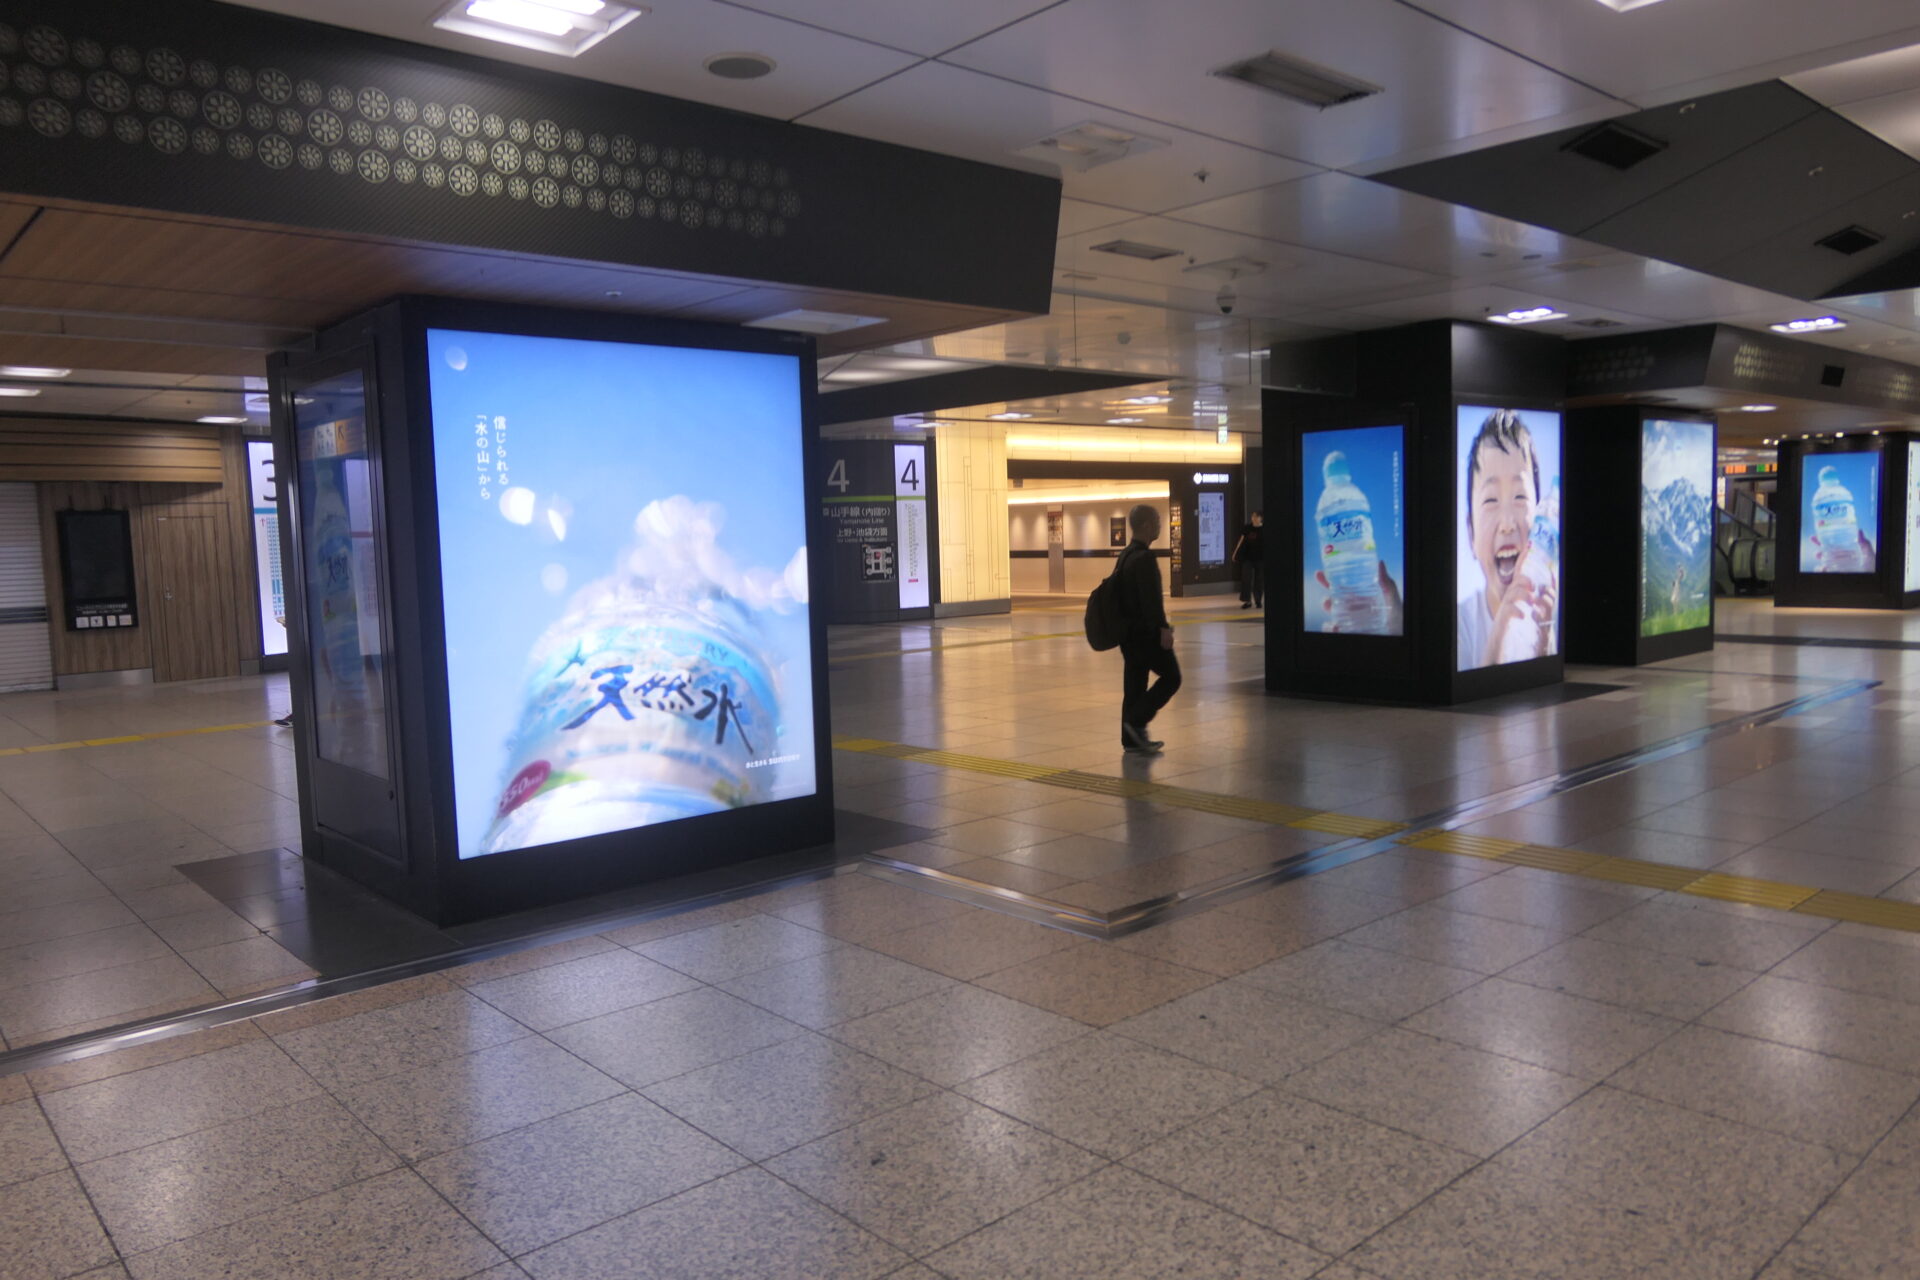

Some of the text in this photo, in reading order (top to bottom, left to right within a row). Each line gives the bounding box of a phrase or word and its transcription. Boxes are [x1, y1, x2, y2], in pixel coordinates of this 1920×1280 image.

[475, 414, 491, 500] 「水の山」から
[493, 415, 509, 485] 信じられる
[827, 459, 850, 493] 4
[900, 459, 919, 491] 4
[561, 665, 754, 755] 天然水
